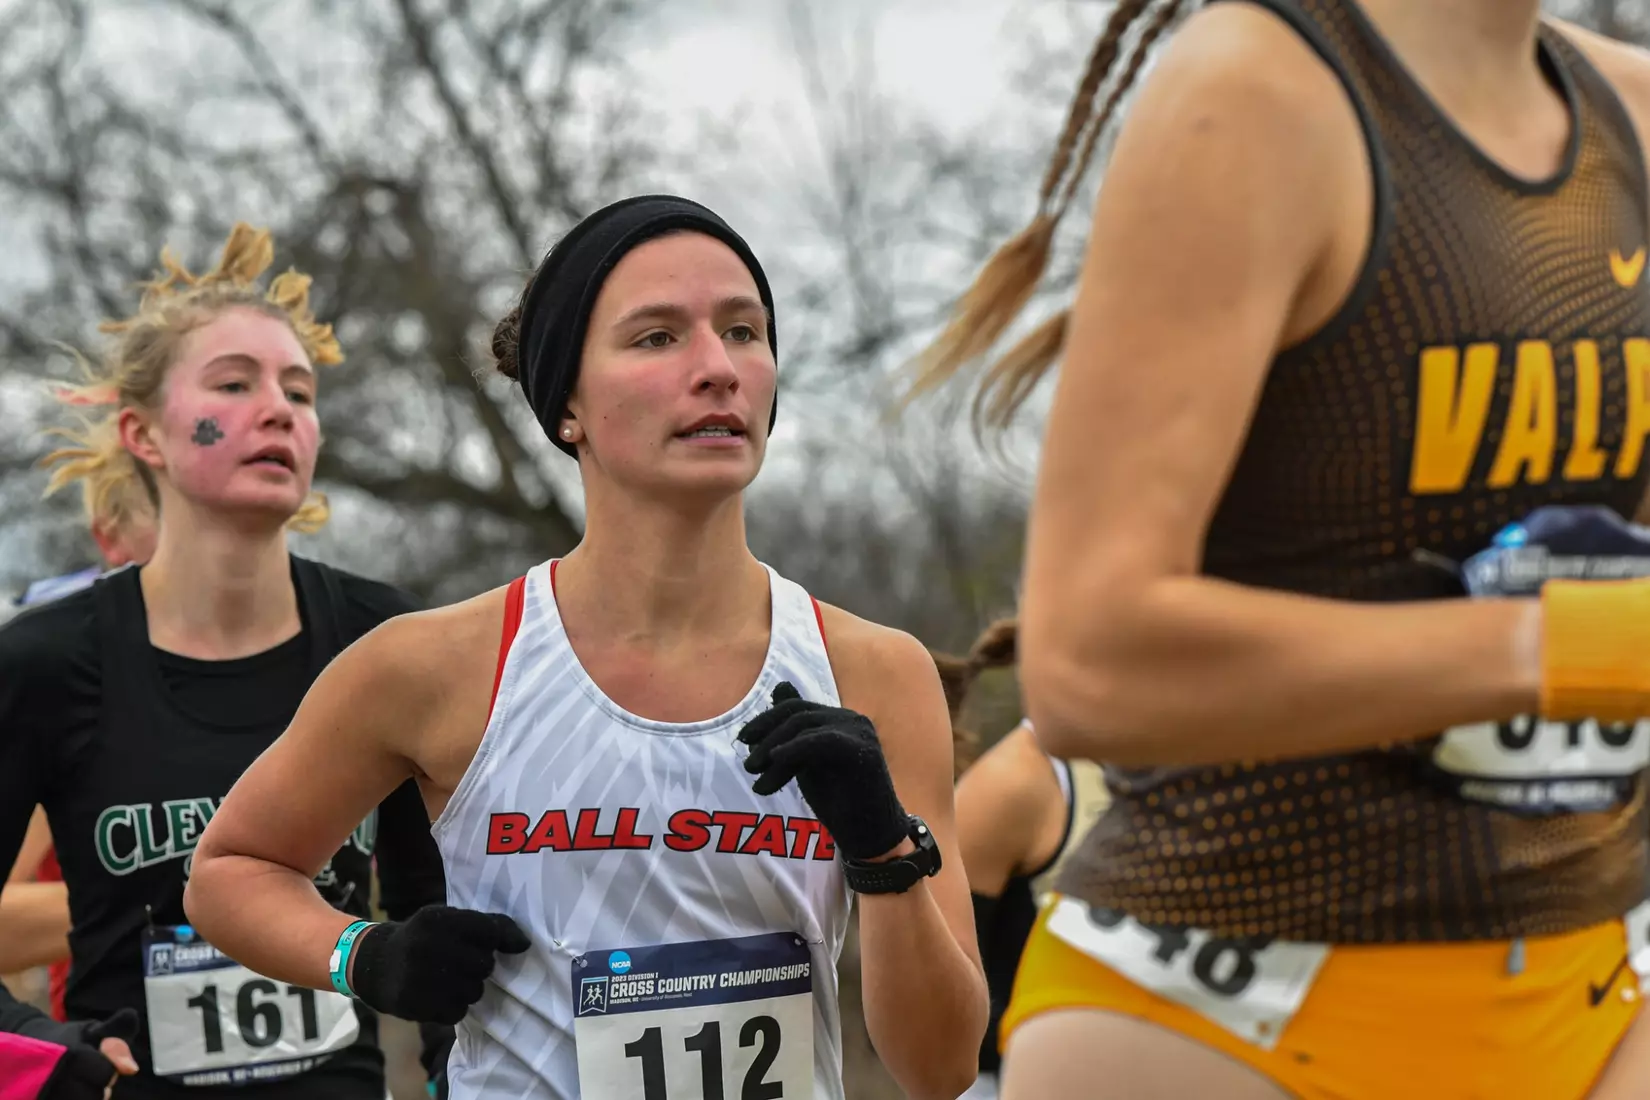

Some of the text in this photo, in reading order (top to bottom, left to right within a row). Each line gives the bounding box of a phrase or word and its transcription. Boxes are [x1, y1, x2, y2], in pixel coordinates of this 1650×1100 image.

[486, 808, 836, 862] BALL STATE
[610, 962, 810, 998] CROSS COUNTRY CHAMPIONSHIPS
[611, 960, 632, 969] NCAA
[611, 974, 627, 982] 2023
[628, 973, 653, 981] DIVISION
[188, 978, 320, 1054] 161
[624, 1015, 784, 1100] 112
